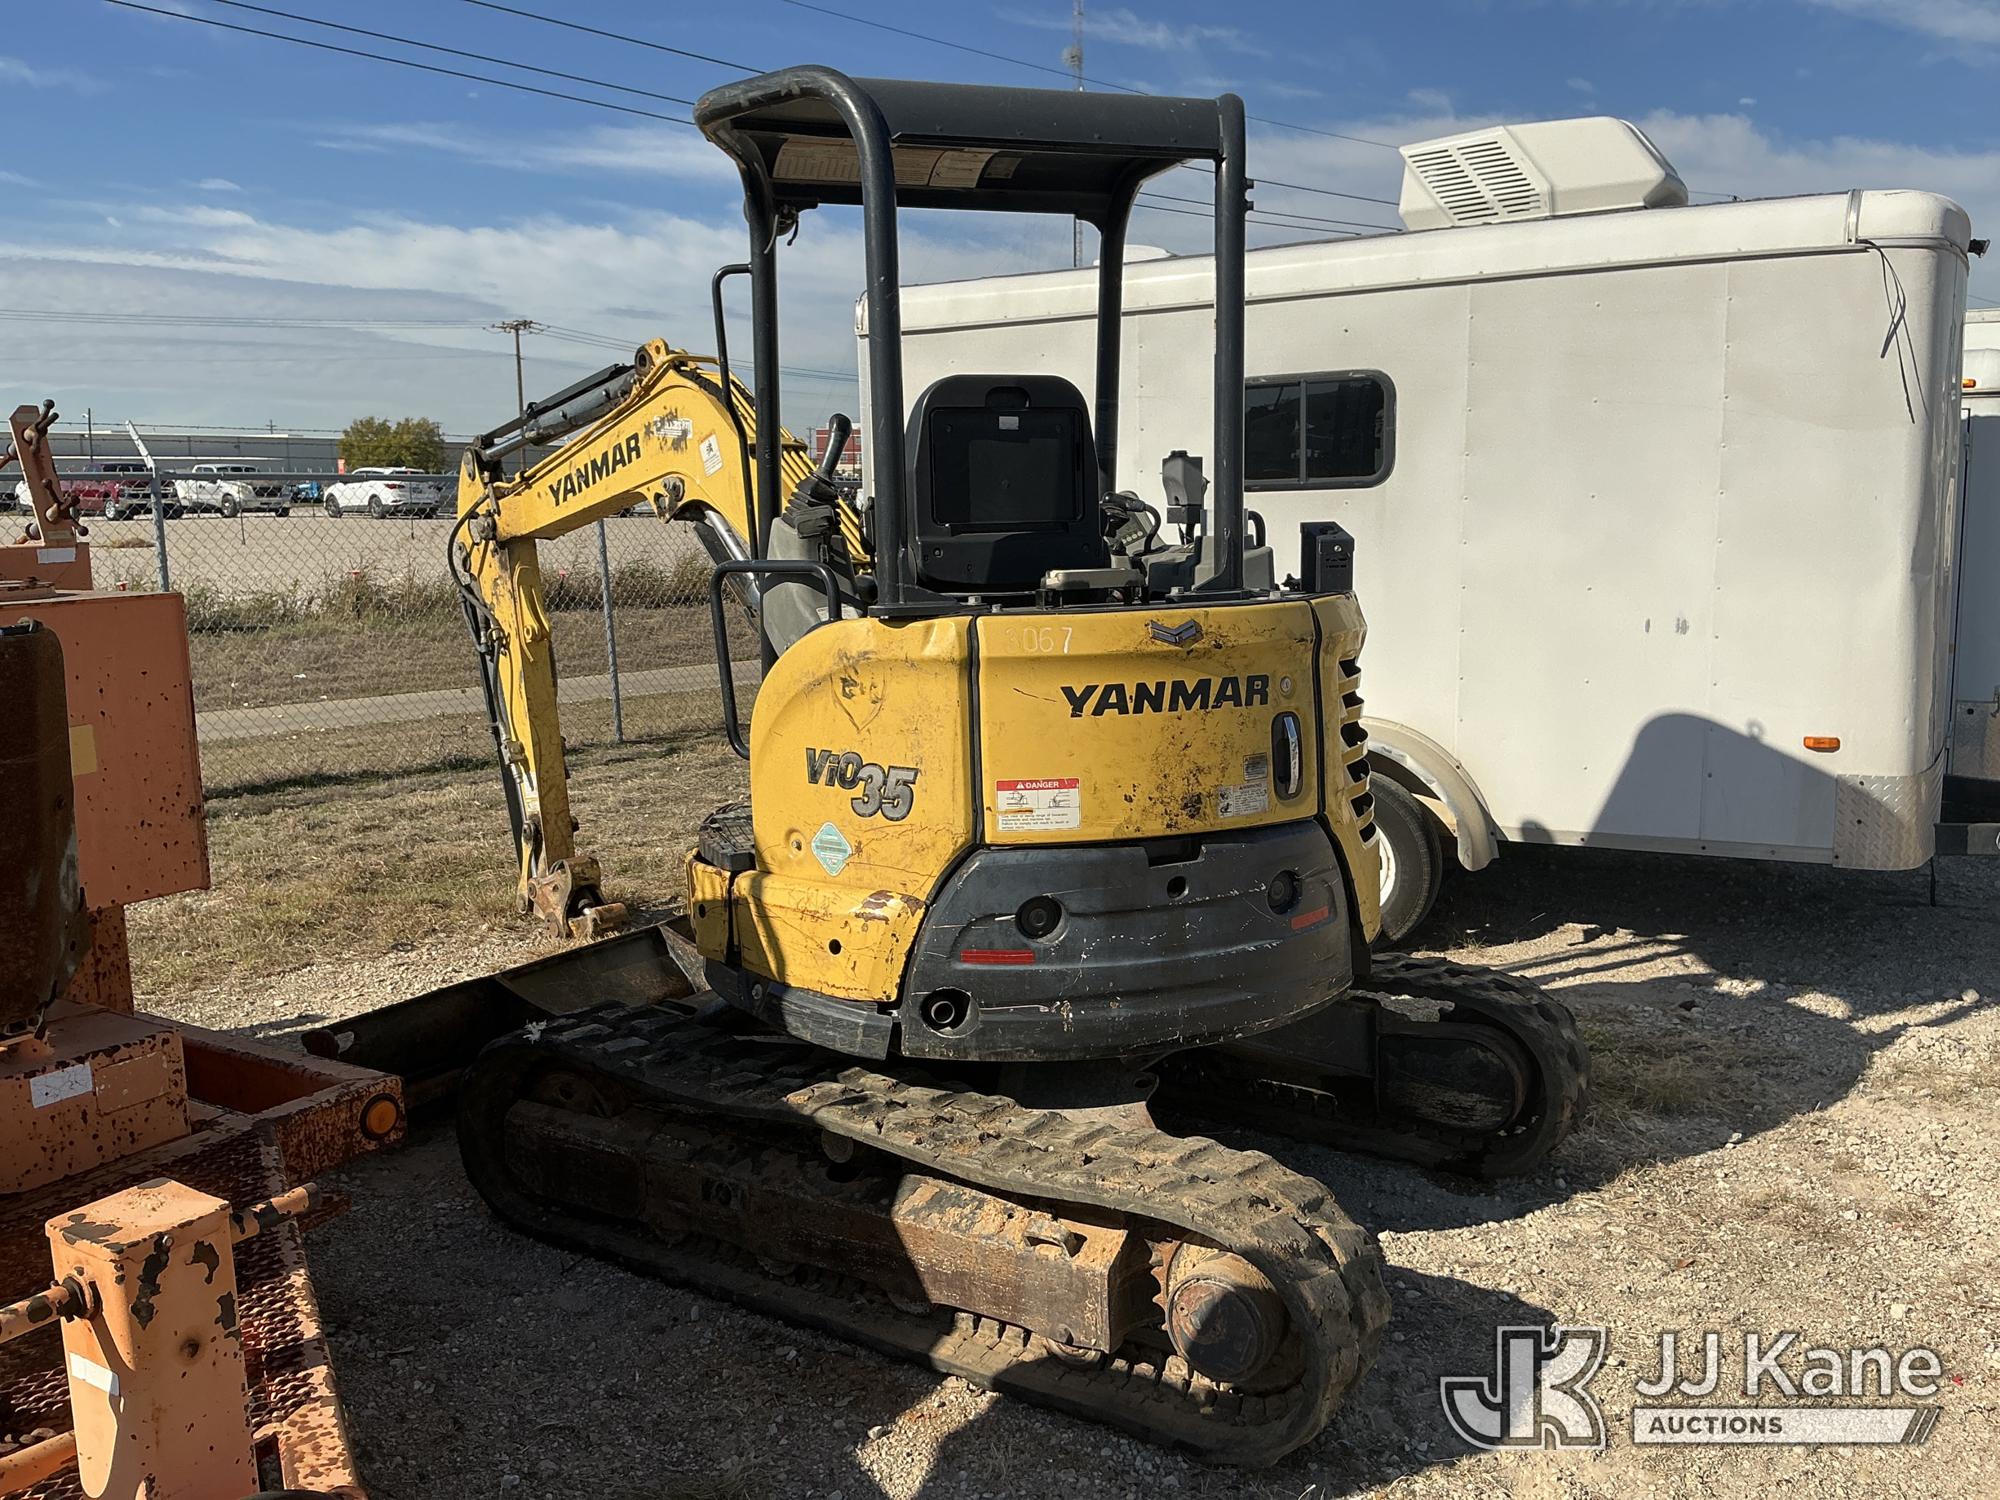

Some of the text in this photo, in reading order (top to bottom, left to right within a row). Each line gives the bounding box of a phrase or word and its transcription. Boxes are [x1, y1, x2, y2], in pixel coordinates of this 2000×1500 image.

[548, 433, 641, 507] YANMAR
[1061, 674, 1269, 717] YANMAR
[1026, 781, 1059, 789] DANGER
